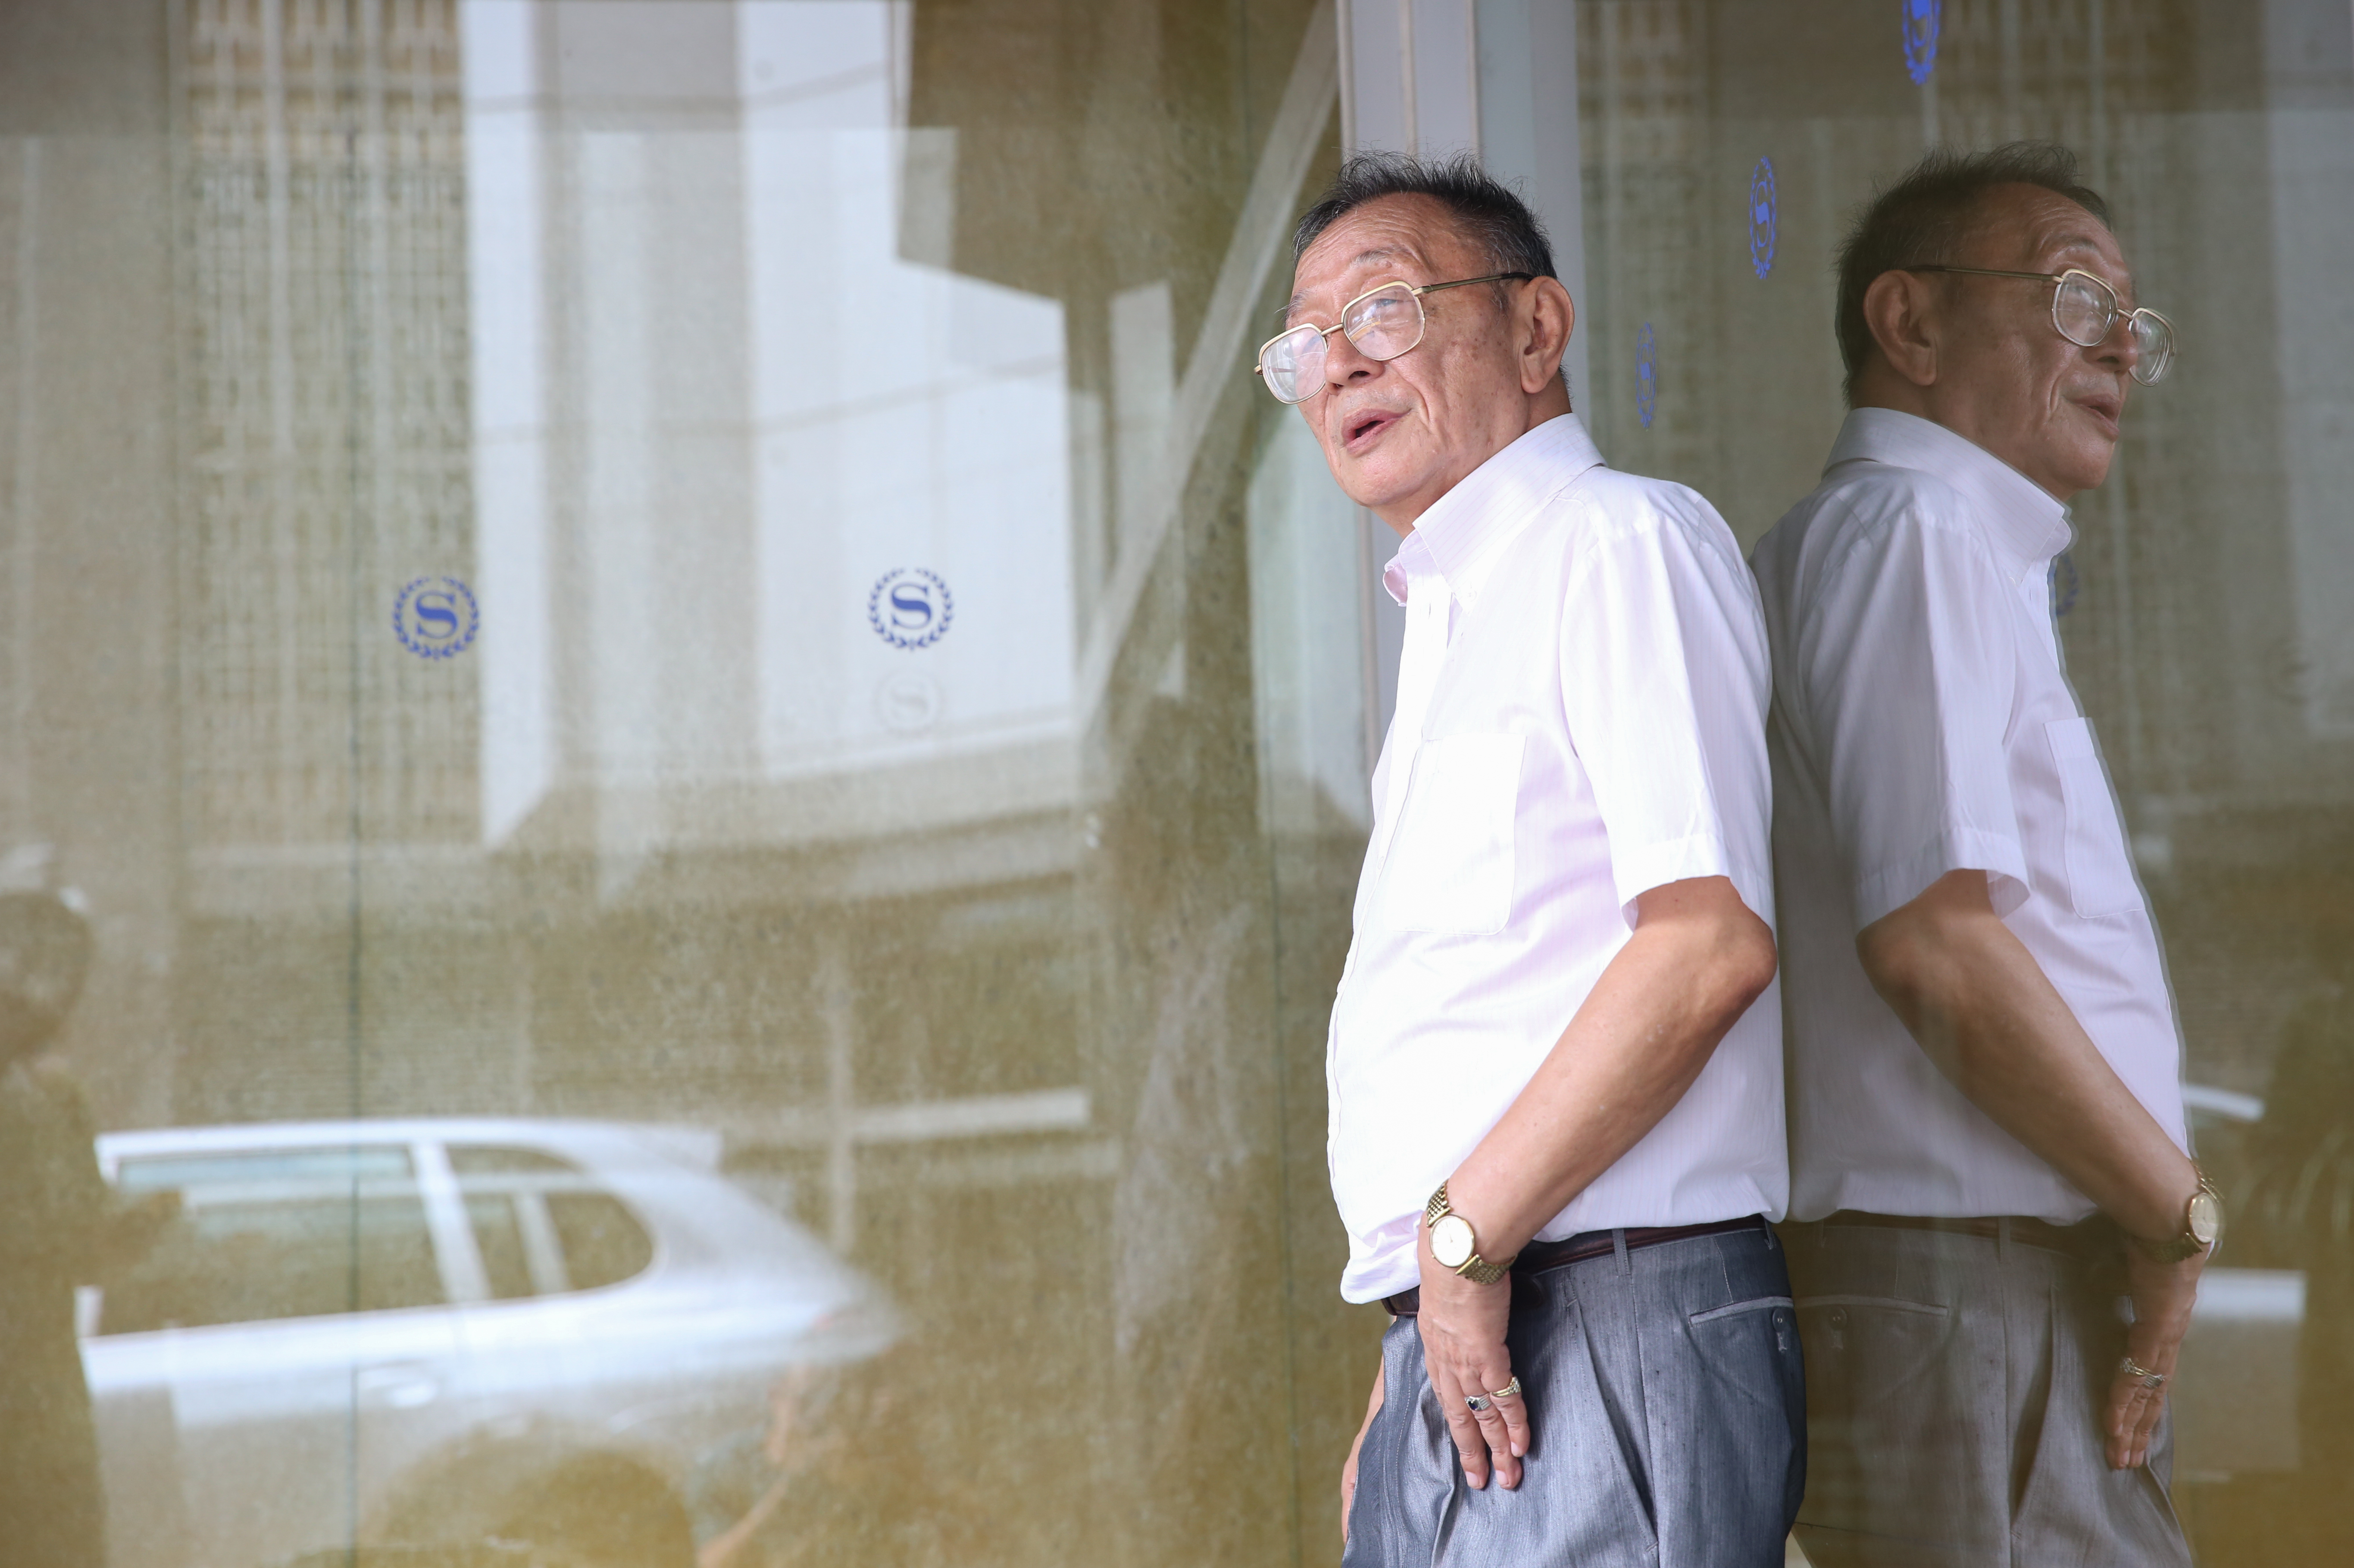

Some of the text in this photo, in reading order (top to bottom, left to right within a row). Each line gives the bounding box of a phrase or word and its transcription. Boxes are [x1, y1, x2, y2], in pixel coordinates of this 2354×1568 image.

[1756, 178, 1769, 250] S
[416, 590, 458, 639] S
[890, 582, 932, 629] S
